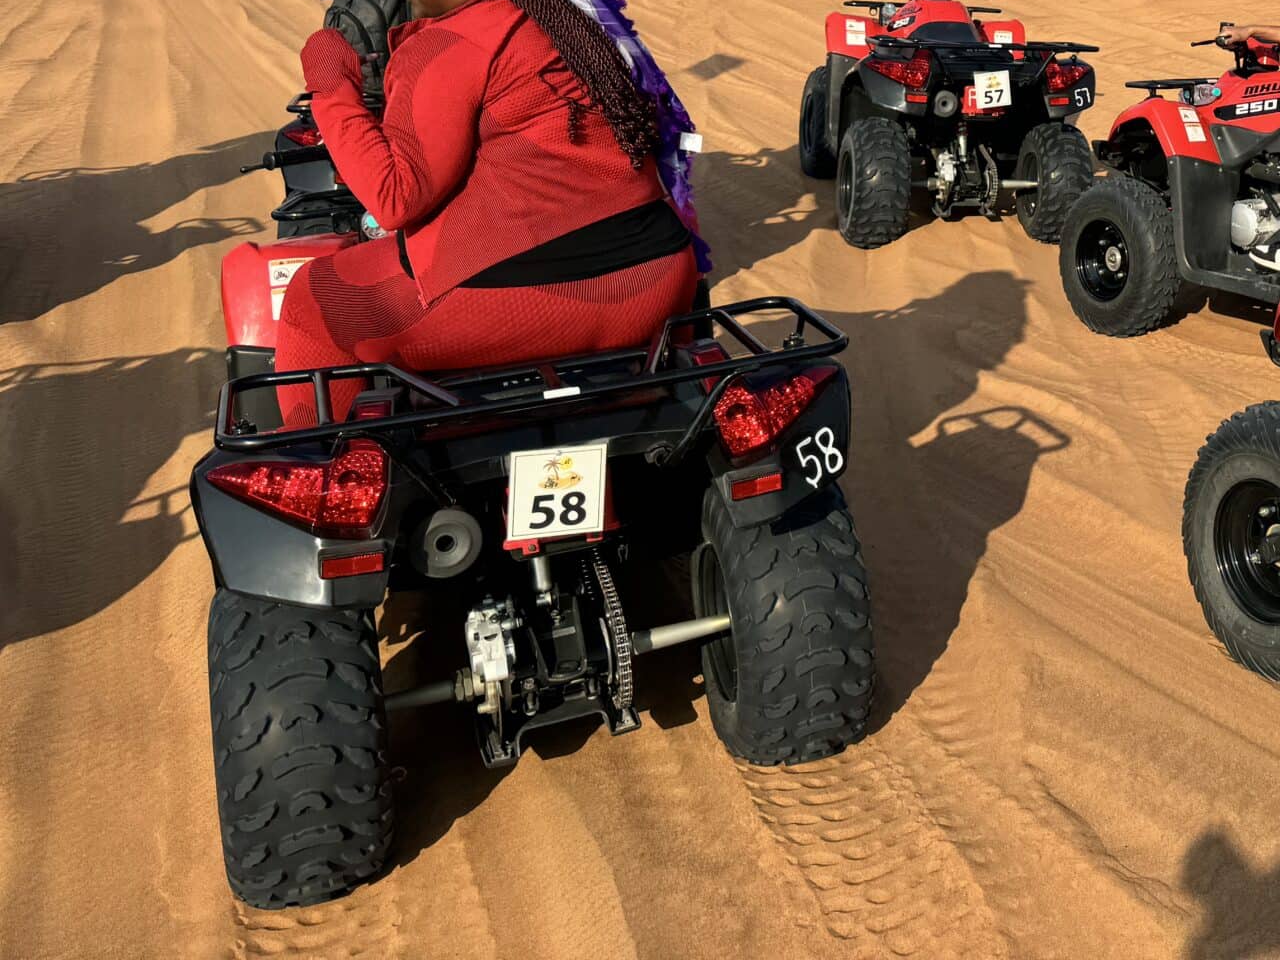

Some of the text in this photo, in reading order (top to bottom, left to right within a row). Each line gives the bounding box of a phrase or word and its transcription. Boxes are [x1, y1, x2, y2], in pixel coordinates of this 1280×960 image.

[984, 89, 1004, 105] 57
[1074, 87, 1091, 107] 57
[1235, 98, 1278, 116] 250
[796, 426, 844, 489] 58
[528, 491, 588, 530] 58
